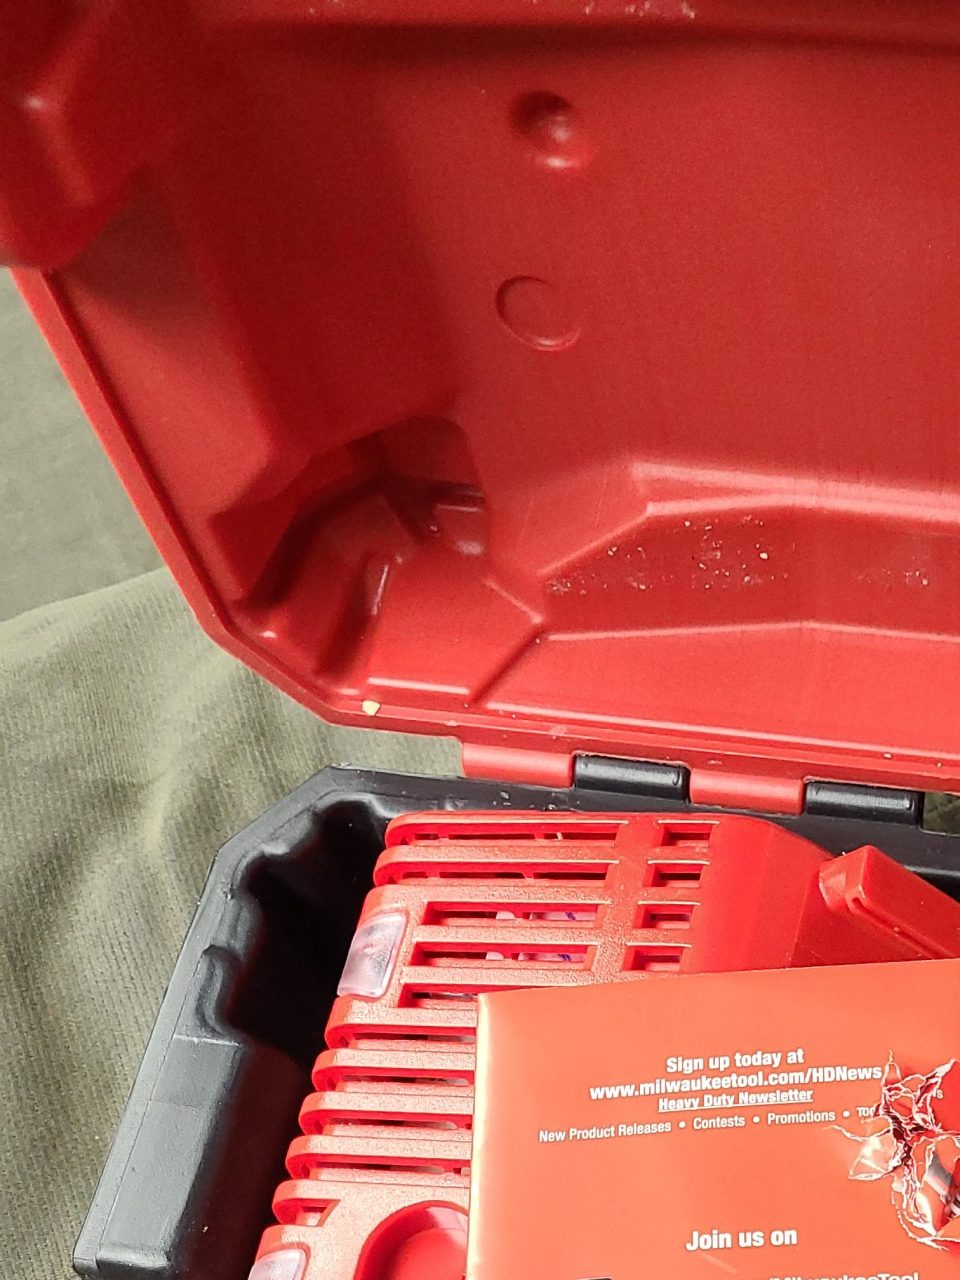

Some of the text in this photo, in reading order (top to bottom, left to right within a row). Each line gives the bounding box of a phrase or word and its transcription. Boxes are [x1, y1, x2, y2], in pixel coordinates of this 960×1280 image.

[666, 1048, 804, 1074] Sign up today at
[589, 1064, 883, 1100] www.milwaukeetool.com/HDNews
[658, 1087, 814, 1111] Heavy Duty Newsletter
[538, 1130, 566, 1144] New
[568, 1126, 616, 1142] Product
[618, 1121, 672, 1138] Releases
[693, 1114, 746, 1130] Contests
[767, 1109, 836, 1126] Promotions
[686, 1228, 798, 1251] Join us on
